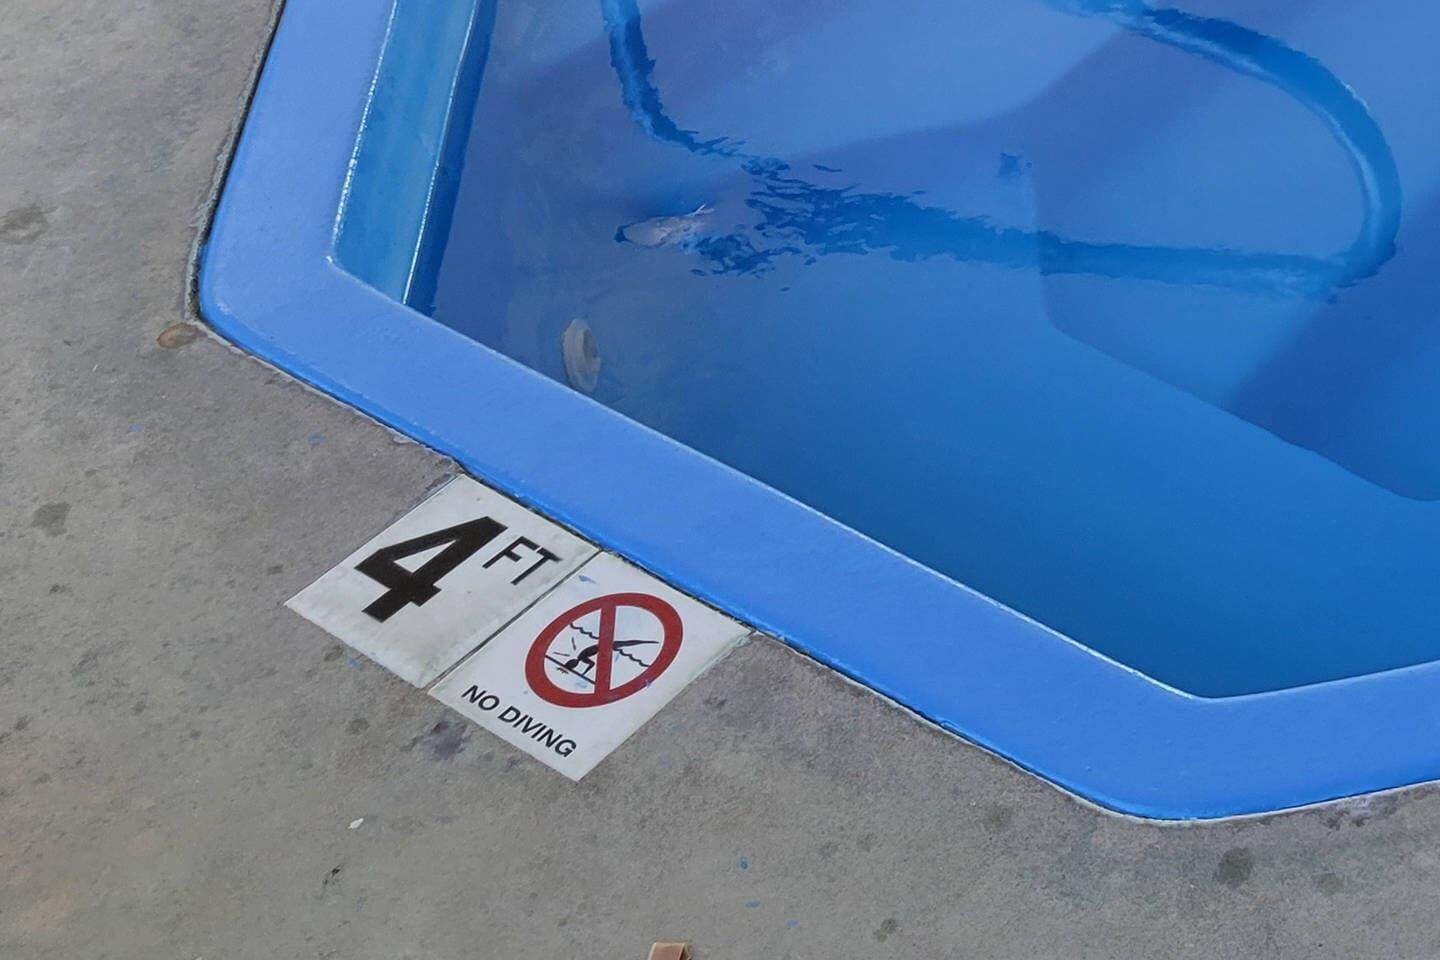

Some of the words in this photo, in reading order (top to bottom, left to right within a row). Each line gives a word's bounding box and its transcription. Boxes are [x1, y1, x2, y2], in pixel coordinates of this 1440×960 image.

[354, 515, 508, 623] 4
[482, 535, 562, 586] FT
[462, 684, 500, 711] NO
[498, 705, 578, 759] DIVING
